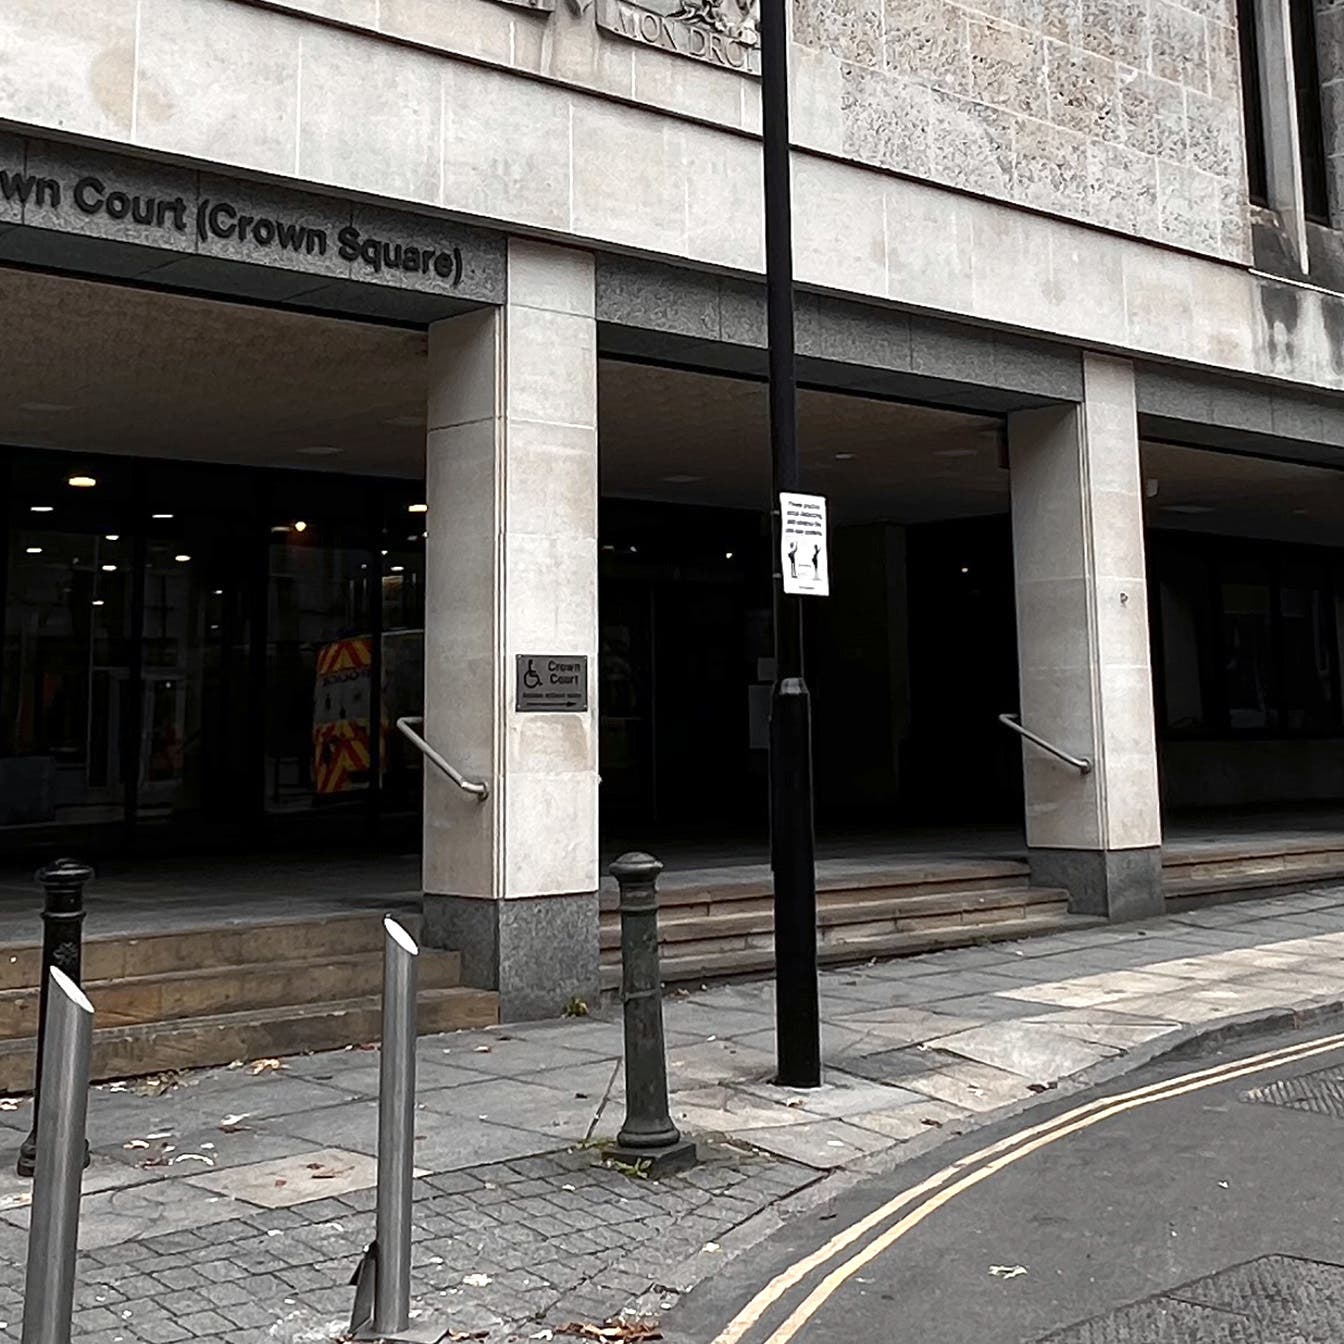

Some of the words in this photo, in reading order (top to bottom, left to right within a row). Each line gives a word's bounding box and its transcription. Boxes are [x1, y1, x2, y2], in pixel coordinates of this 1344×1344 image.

[613, 6, 679, 51] MON
[688, 26, 761, 73] DROI
[72, 175, 187, 232] Court
[195, 199, 327, 257] (Crown
[337, 224, 464, 290] Square)
